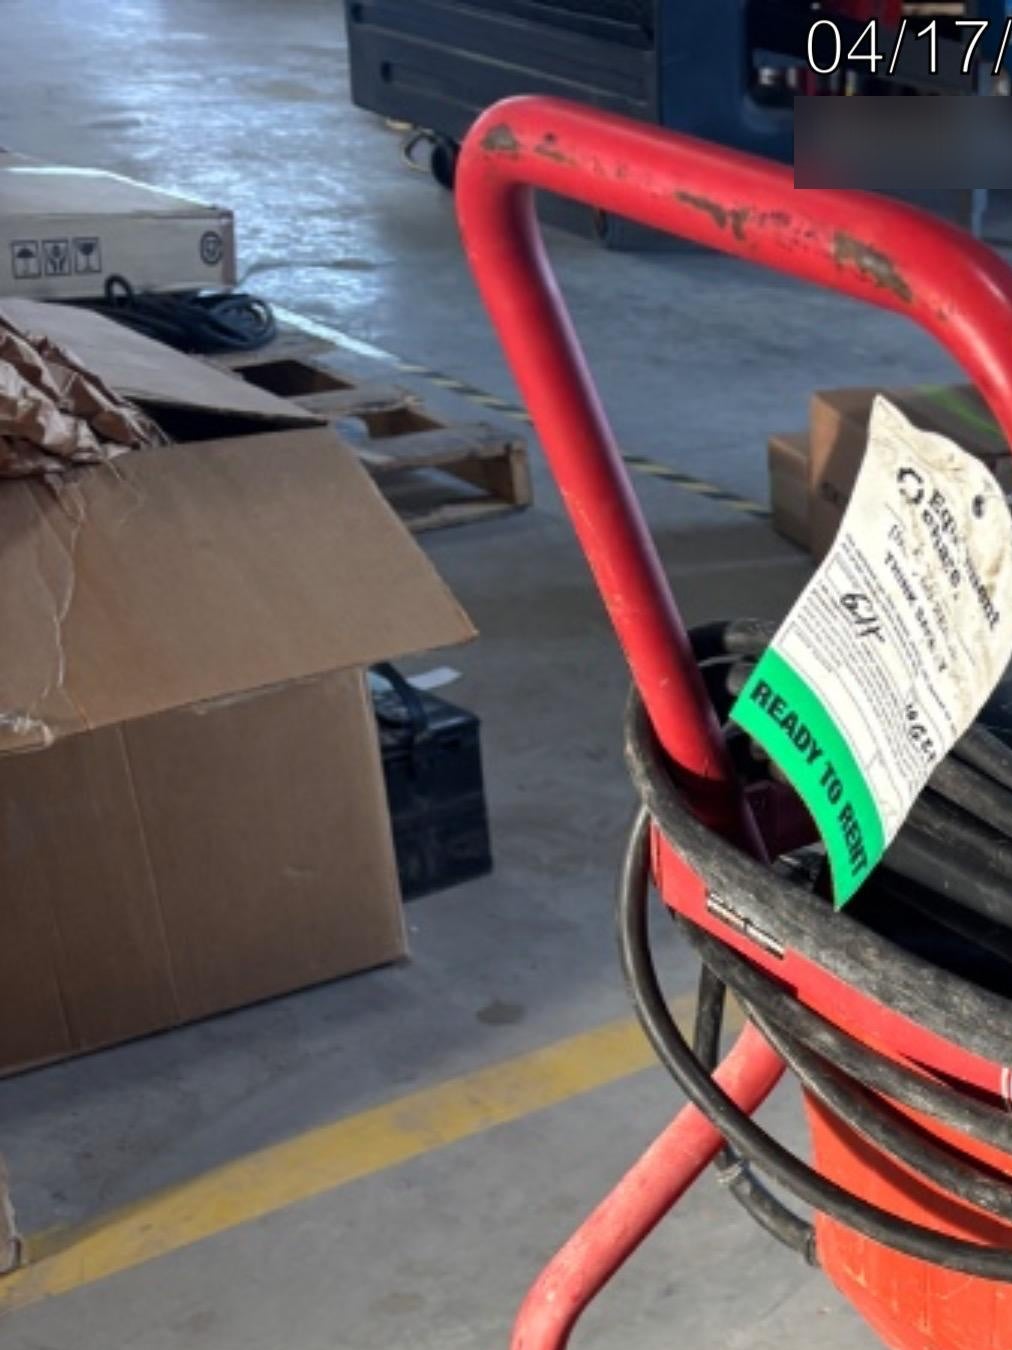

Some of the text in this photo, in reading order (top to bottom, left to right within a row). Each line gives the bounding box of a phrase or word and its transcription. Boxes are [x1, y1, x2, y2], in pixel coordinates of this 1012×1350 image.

[929, 488, 1000, 631] Equment
[750, 679, 868, 877] READY TO RENT
